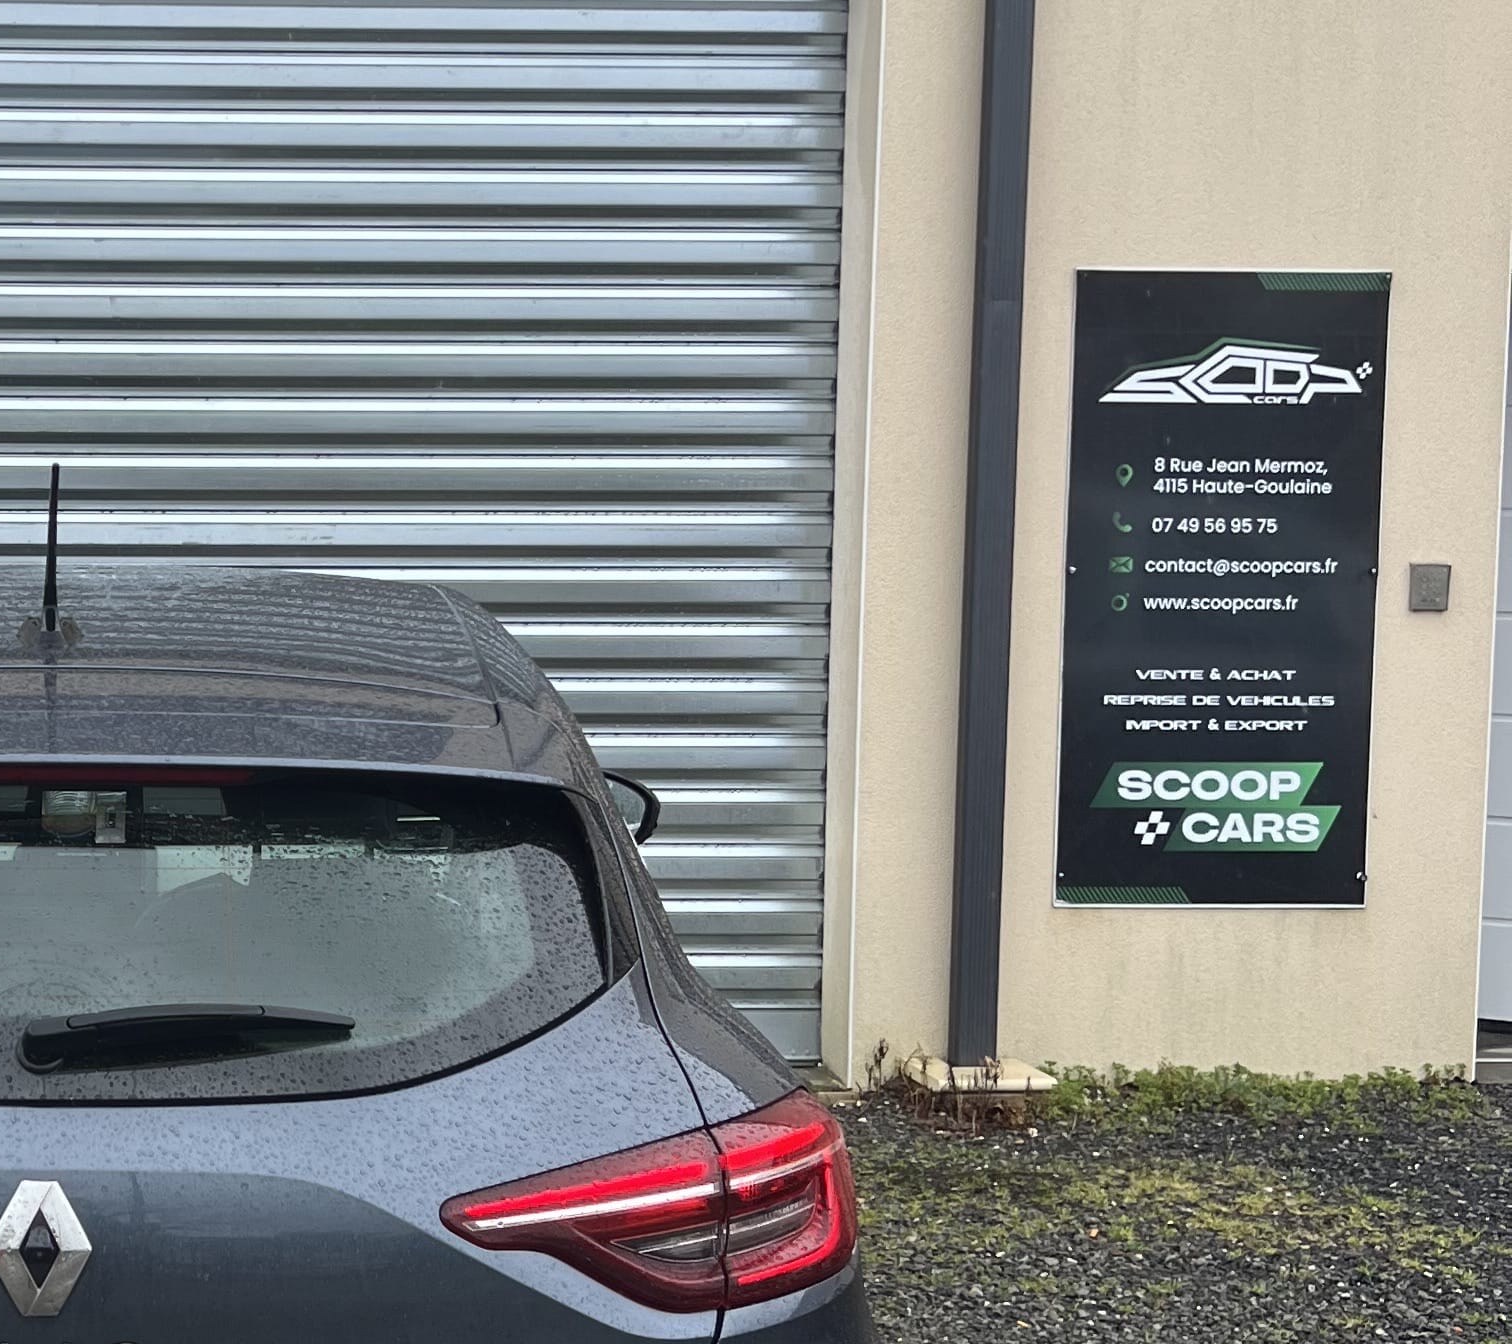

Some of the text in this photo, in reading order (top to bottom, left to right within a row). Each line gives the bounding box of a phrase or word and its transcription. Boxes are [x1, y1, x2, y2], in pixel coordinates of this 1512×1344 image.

[1252, 395, 1300, 405] cars
[1154, 457, 1329, 477] 8 Rue Jean Mermoz,
[1152, 478, 1333, 495] 4115 Haute-Goulaine
[1151, 517, 1279, 534] 07 49 56 95 75
[1144, 557, 1339, 578] contact@scoopcars.fr
[1143, 594, 1299, 615] www.scoopcars.fr
[1135, 667, 1297, 681] VENTE & ACHAT
[1103, 694, 1336, 707] REPRISE DE VEHICULES
[1125, 718, 1309, 731] IMPORT & EXPORT
[1116, 769, 1302, 801] SCOOP
[1181, 812, 1321, 844] CARS
